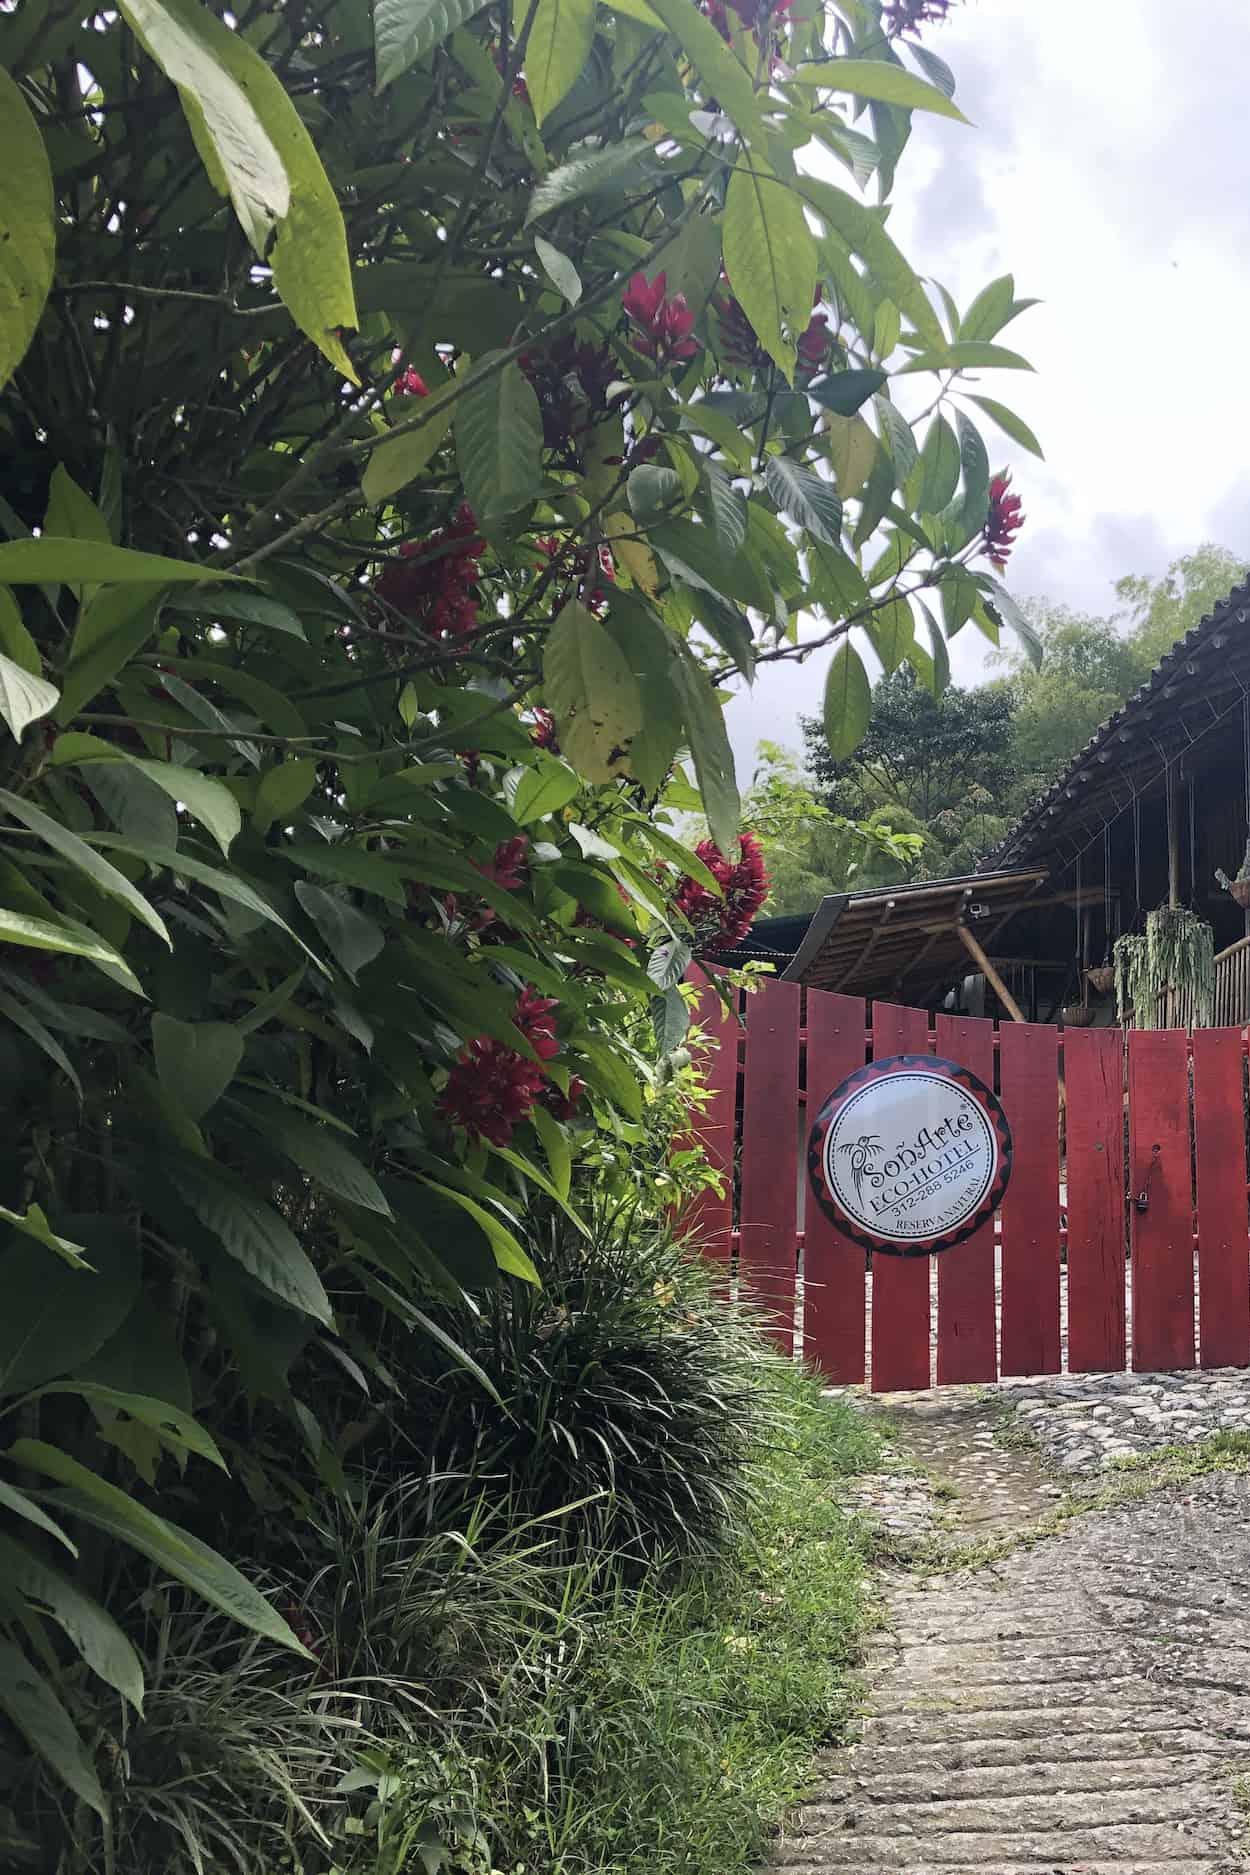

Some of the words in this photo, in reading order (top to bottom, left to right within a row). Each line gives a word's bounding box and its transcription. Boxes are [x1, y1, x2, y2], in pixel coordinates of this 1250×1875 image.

[870, 1139, 979, 1212] ECO-HOTEL
[891, 1182, 942, 1217] 312-288
[943, 1160, 974, 1184] 5246
[896, 1214, 943, 1230] RESERVA
[943, 1176, 982, 1217] NATURAL
